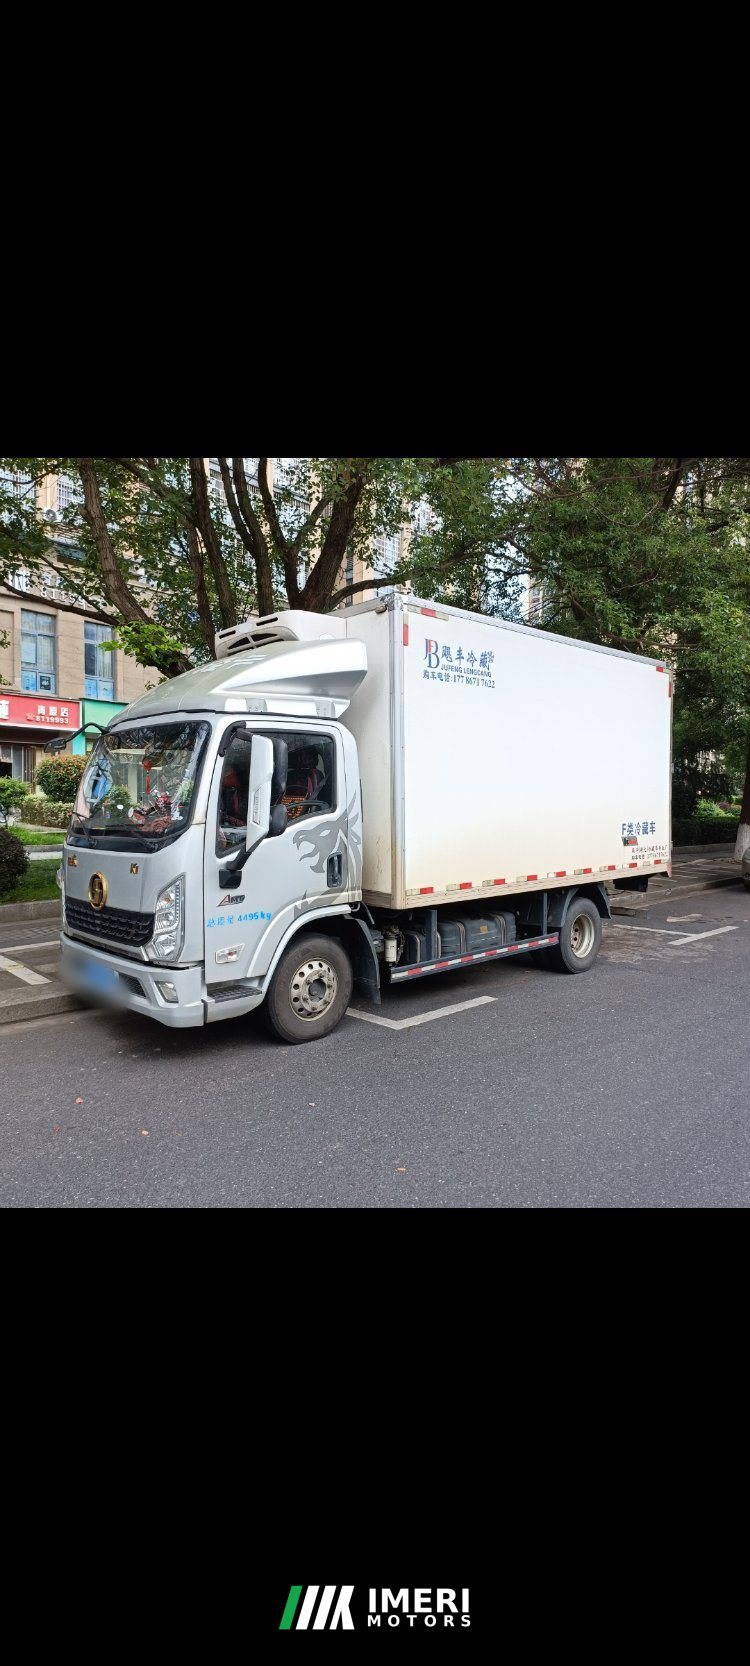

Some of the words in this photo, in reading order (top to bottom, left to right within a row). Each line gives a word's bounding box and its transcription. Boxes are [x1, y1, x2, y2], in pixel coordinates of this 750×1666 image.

[441, 664, 462, 674] JUFENG
[464, 667, 492, 678] LENGCANG
[622, 821, 656, 836] F类冷藏车
